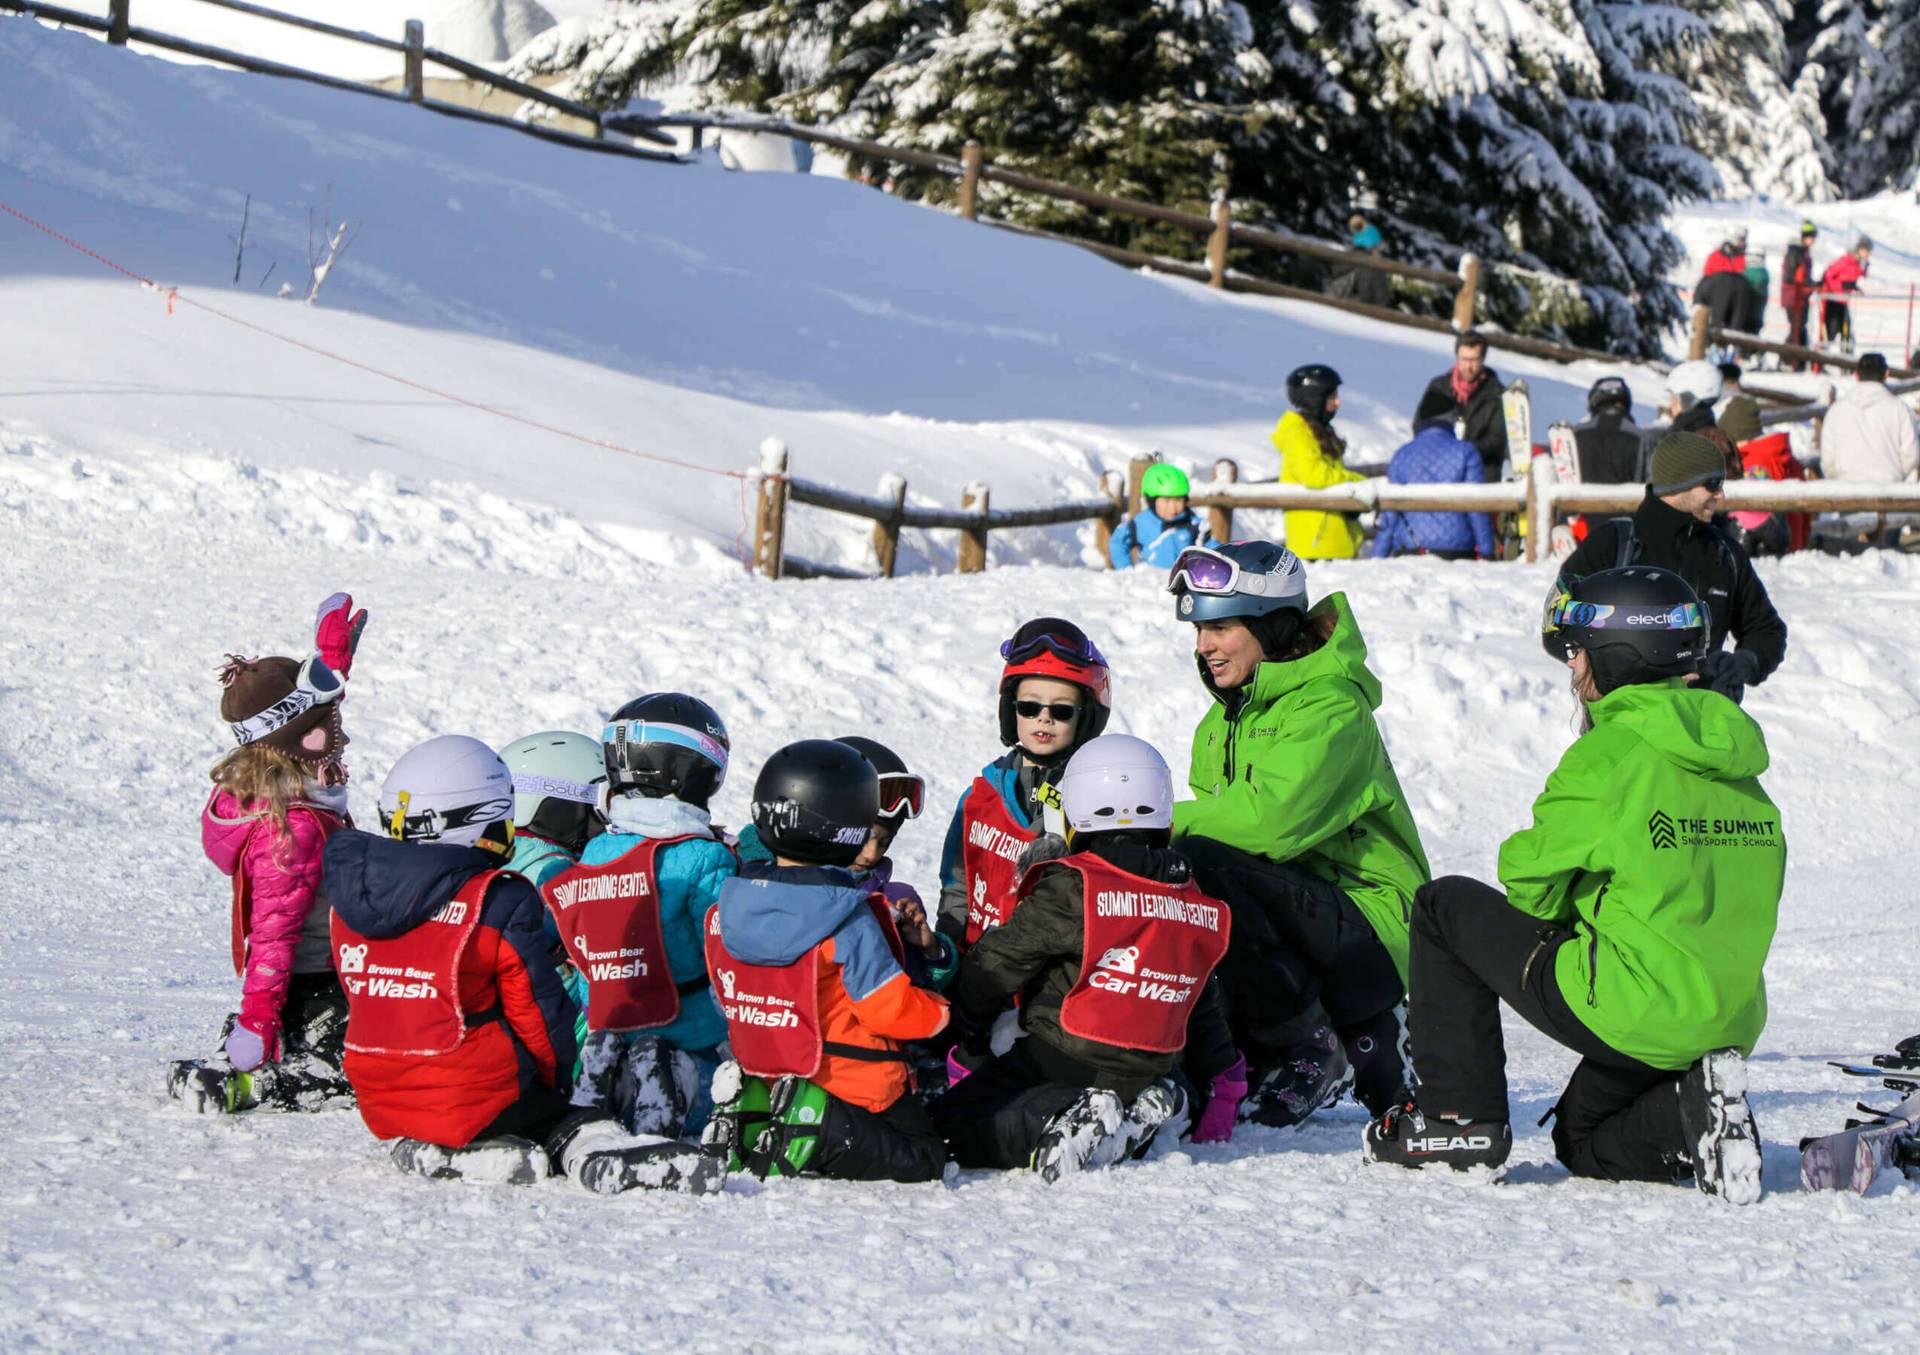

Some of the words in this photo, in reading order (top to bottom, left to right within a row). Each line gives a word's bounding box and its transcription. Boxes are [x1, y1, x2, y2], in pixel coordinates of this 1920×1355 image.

[1626, 613, 1684, 625] electric
[1678, 819, 1708, 833] THE
[1713, 819, 1774, 835] SUMMIT
[578, 873, 618, 902] LEARNING
[618, 872, 650, 898] CENTER
[1097, 891, 1138, 917] SUMMIT
[1139, 892, 1187, 923] LEARNING
[1186, 901, 1219, 932] CENTER
[588, 950, 617, 960] Brown
[619, 948, 645, 957] Bear
[367, 964, 402, 976] Brown
[404, 967, 436, 980] Bear
[590, 959, 648, 981] Wash
[1139, 967, 1177, 983] Brown
[368, 978, 438, 999] Wash
[1088, 971, 1137, 995] Car
[1138, 980, 1191, 1003] Wash
[736, 991, 764, 1004] Brown
[766, 995, 795, 1008] Bear
[725, 1005, 737, 1020] ar
[738, 1004, 799, 1027] Wash
[1406, 1136, 1492, 1152] HEAD
